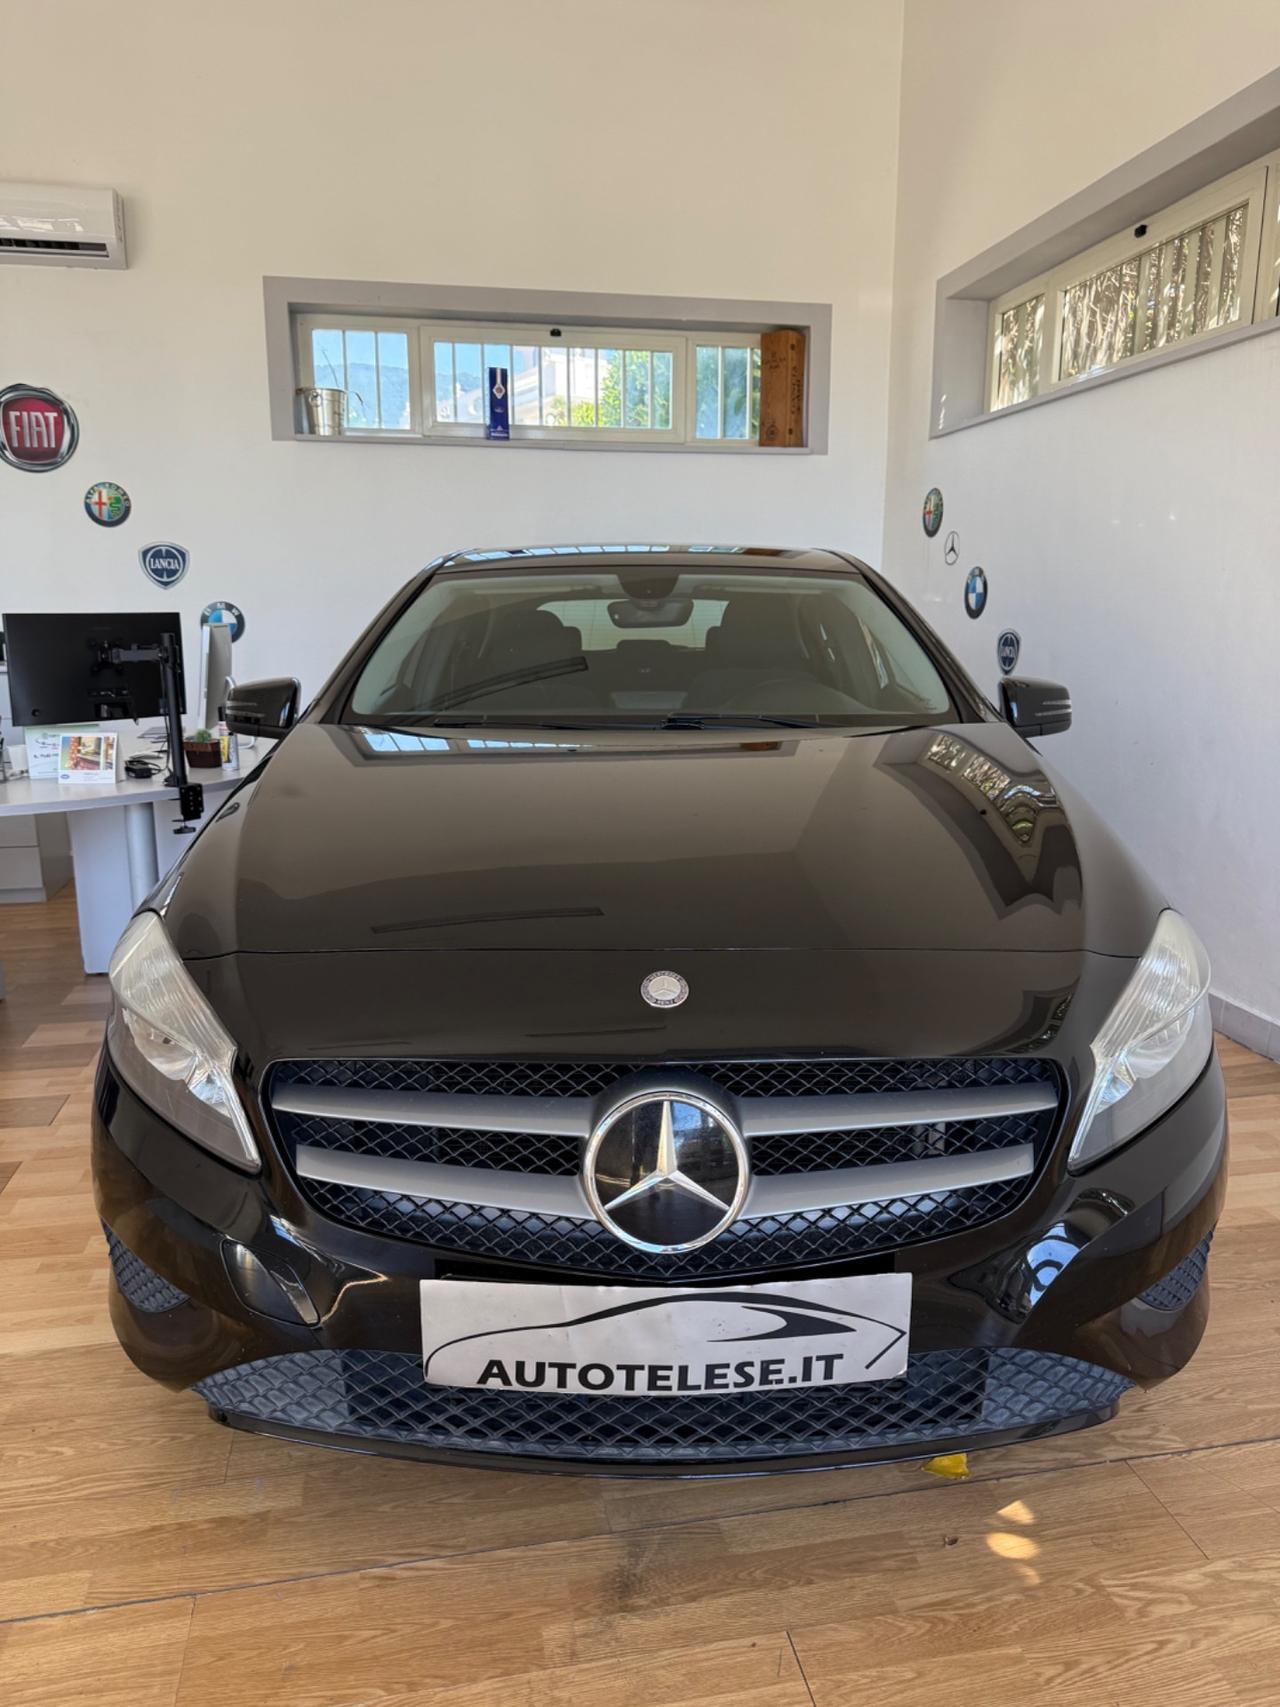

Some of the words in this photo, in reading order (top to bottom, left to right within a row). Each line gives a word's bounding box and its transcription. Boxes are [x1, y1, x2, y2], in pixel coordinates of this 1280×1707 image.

[9, 411, 58, 448] FIAT
[150, 558, 179, 569] LANCIA
[477, 1353, 844, 1391] AUTOTELESE.IT
